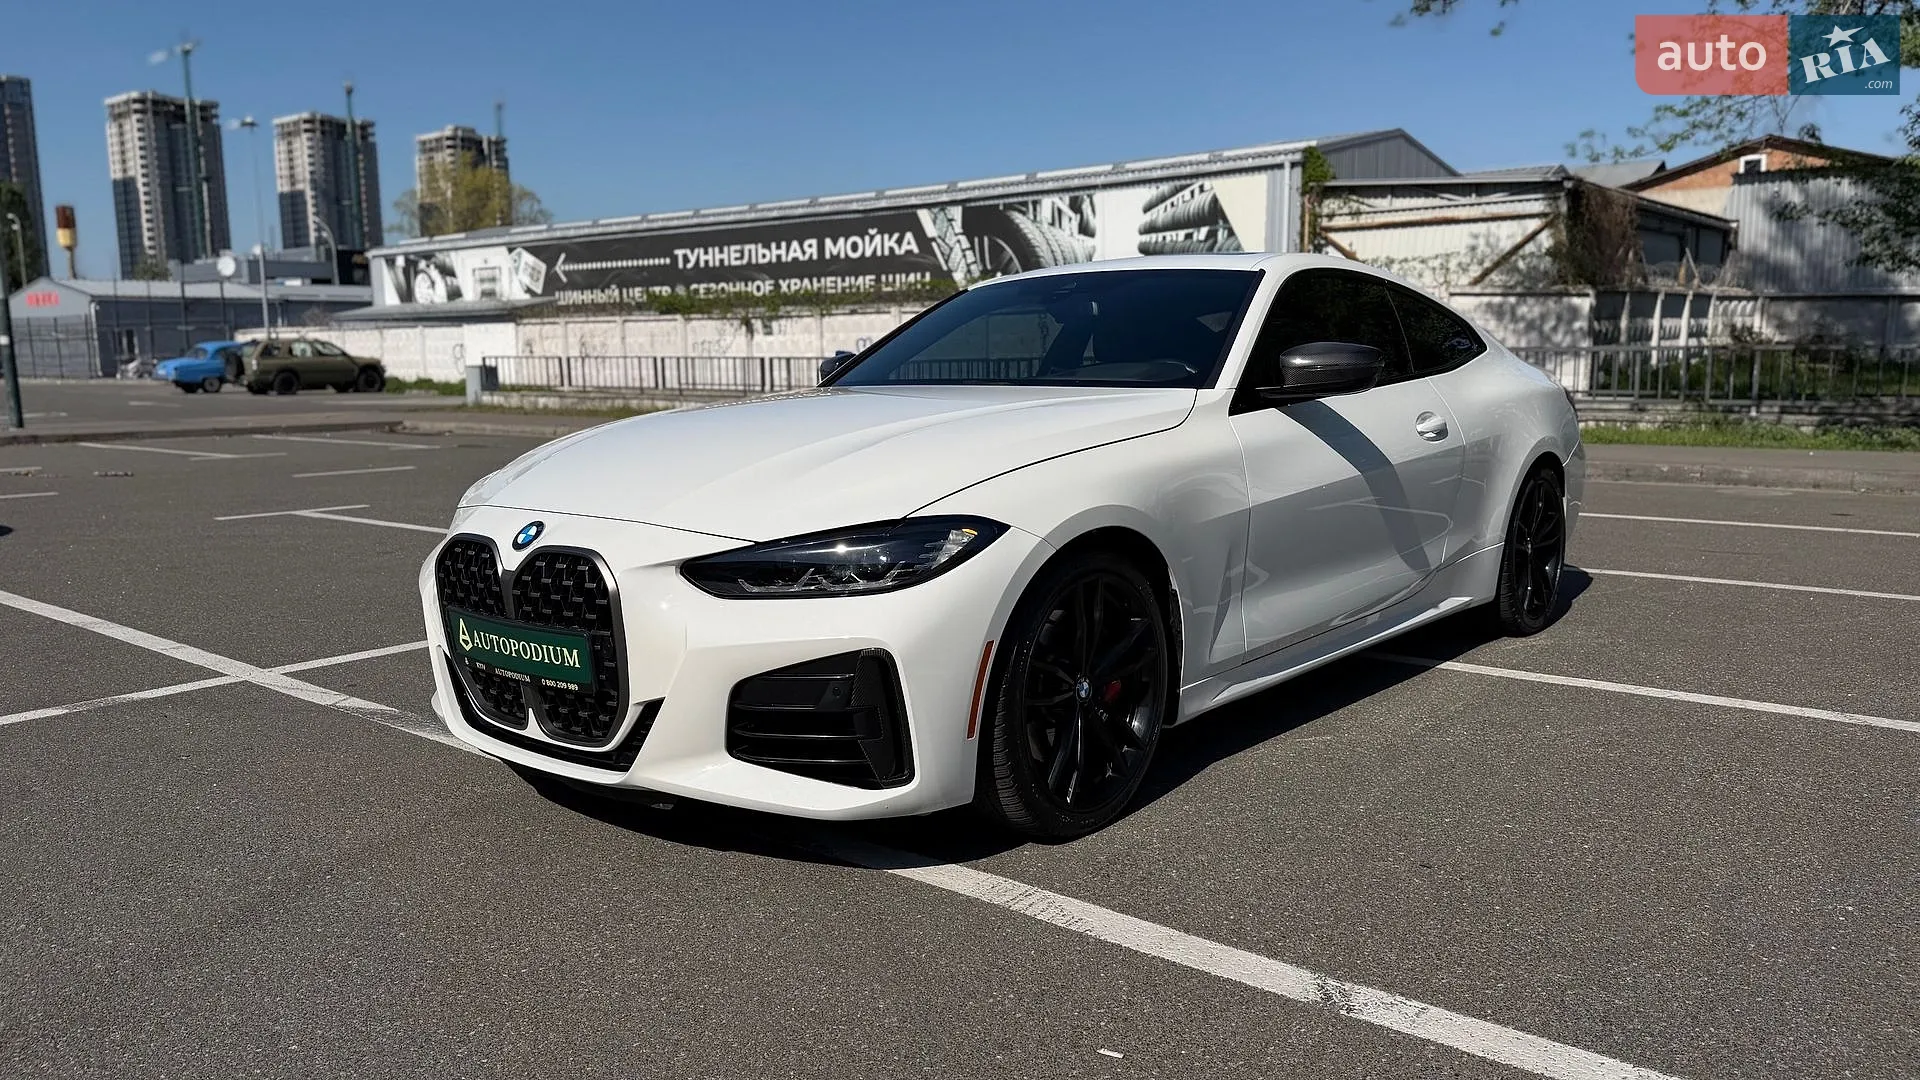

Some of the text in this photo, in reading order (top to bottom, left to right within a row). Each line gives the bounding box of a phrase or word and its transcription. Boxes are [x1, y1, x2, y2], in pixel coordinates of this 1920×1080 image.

[673, 228, 920, 269] ТУННЕЛЬНАЯ МОЙКА
[555, 284, 620, 305] ШИННЫЙ
[474, 630, 581, 668] AUTOPODIUM
